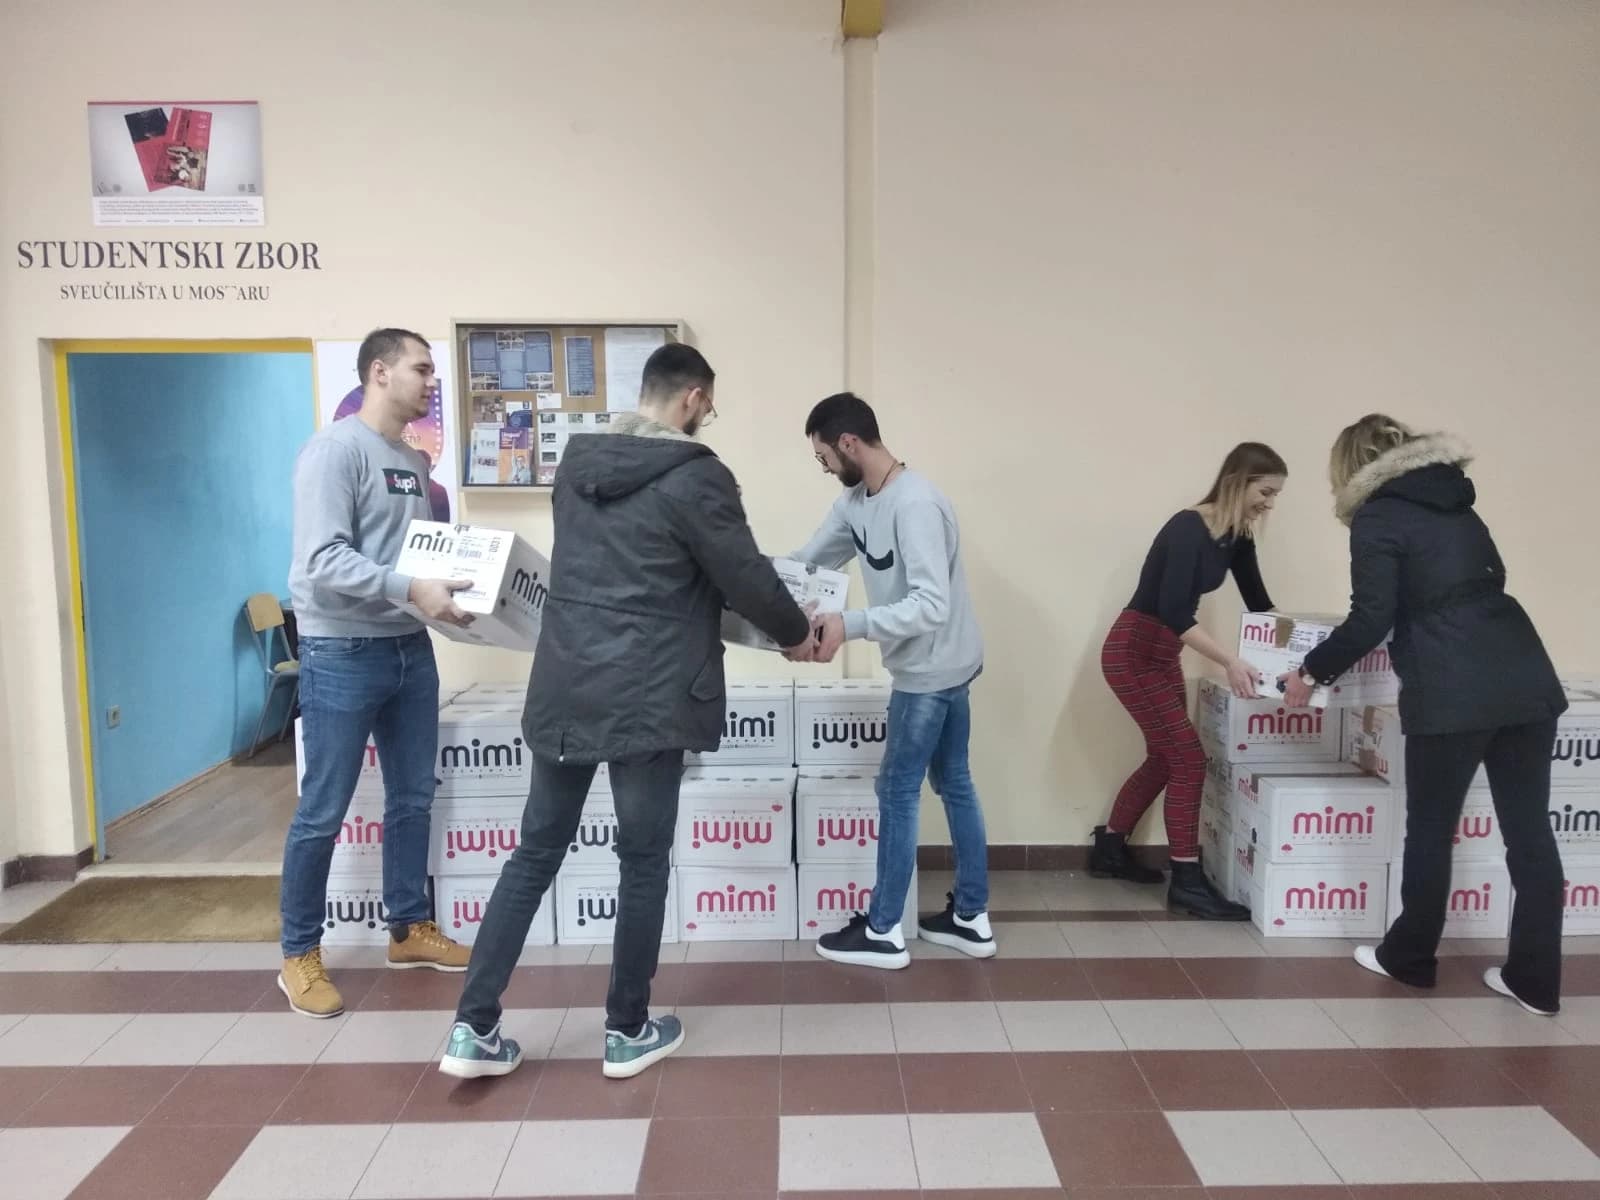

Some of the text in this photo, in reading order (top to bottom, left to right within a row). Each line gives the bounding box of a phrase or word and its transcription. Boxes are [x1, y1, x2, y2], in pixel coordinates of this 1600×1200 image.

[17, 240, 322, 271] STUDENTSKI ZBOR
[60, 281, 166, 301] SVEUČILIŠTA
[172, 285, 184, 301] U
[511, 567, 549, 610] mim
[1244, 622, 1276, 645] mi
[811, 721, 887, 750] mimi
[1247, 708, 1323, 735] mimi
[440, 737, 522, 768] mimi
[1293, 805, 1376, 834] mimi
[1452, 816, 1492, 845] mi
[570, 825, 615, 853] imi
[692, 821, 773, 850] mimi
[696, 884, 776, 913] mimi
[816, 881, 871, 911] mi
[1284, 881, 1369, 910] mimi
[1450, 882, 1492, 912] mi
[1562, 879, 1600, 908] im
[453, 901, 484, 929] mi
[577, 898, 616, 927] mi
